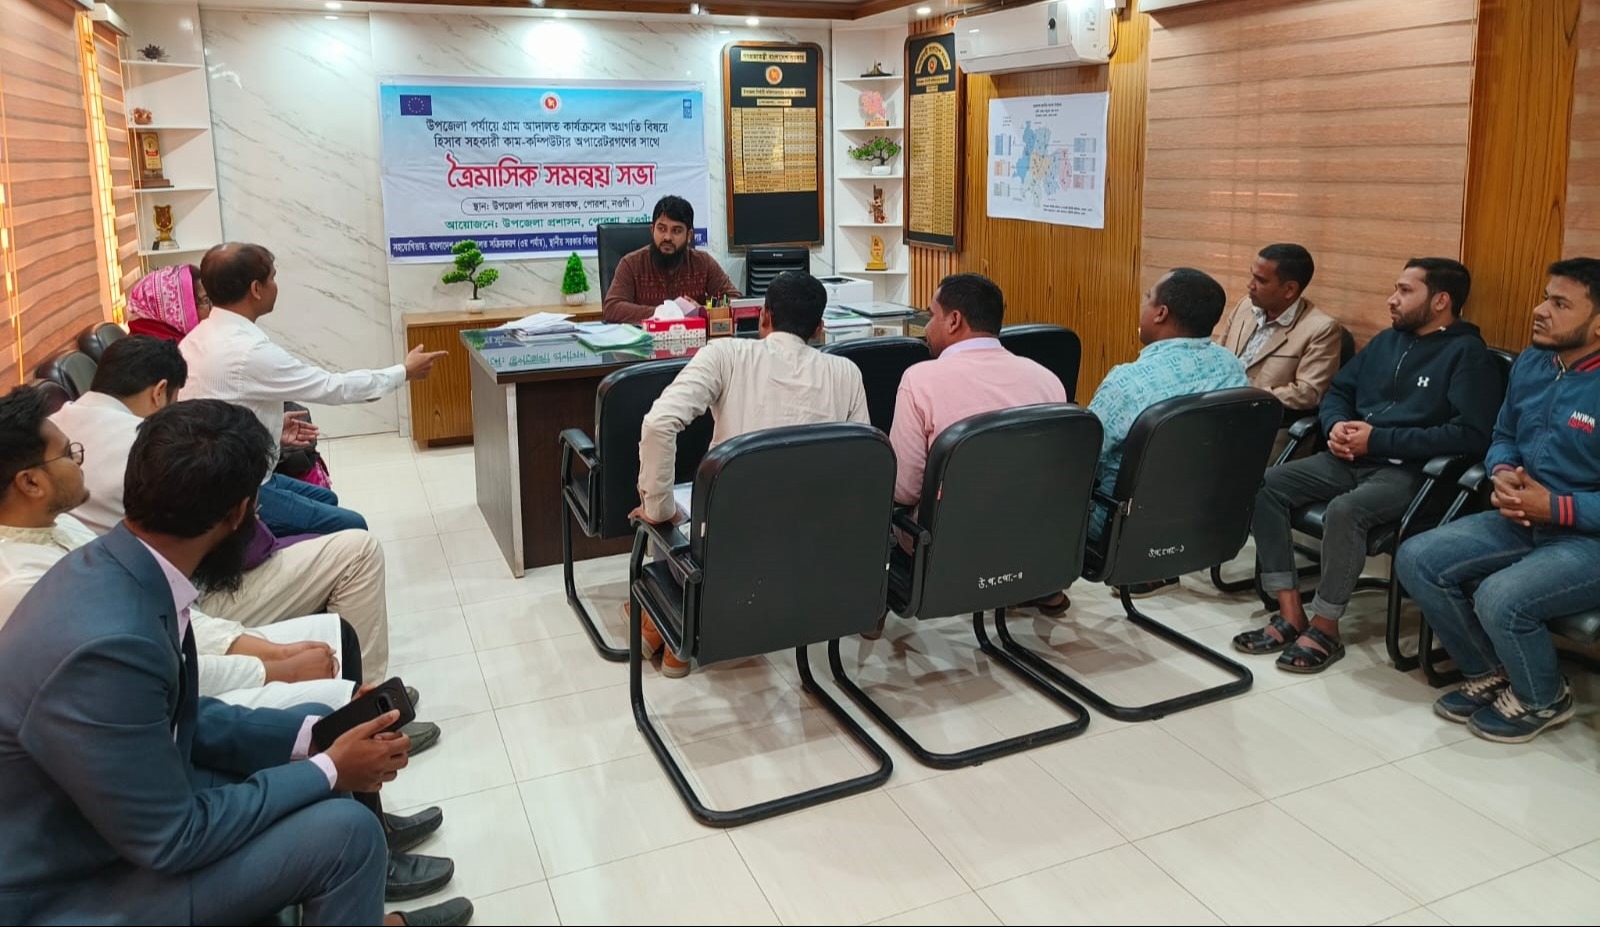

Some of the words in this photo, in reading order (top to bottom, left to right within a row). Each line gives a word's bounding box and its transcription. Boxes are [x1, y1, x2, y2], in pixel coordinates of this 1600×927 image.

[426, 118, 467, 132] উপজেলা
[470, 117, 499, 132] পর্যায়ে
[502, 120, 520, 132] গ্রাম
[523, 120, 560, 132] আদালত
[562, 119, 606, 133] কার্যক্রমের
[609, 119, 642, 132] অগ্রগতি
[644, 119, 668, 133] বিষয়ে
[433, 133, 462, 148] হিসাব
[465, 132, 500, 148] সহকারী
[502, 134, 571, 148] কাম-কম্পিউটার
[574, 135, 637, 148] অপারেটরগণের
[640, 137, 660, 148] সাথে
[446, 153, 539, 189] ত্রৈমাসিক
[543, 164, 611, 189] সমন্বয়
[616, 164, 655, 186] সভা
[472, 202, 490, 214] স্থান:
[492, 200, 523, 211] উপজেলা
[525, 199, 548, 211] পরিষদ
[551, 199, 581, 211] সভাকক্ষ,
[583, 199, 610, 210] পোরশা,
[444, 219, 498, 231] আয়োজনে:
[502, 217, 543, 229] উপজেলা
[547, 217, 584, 228] প্রশাসন,
